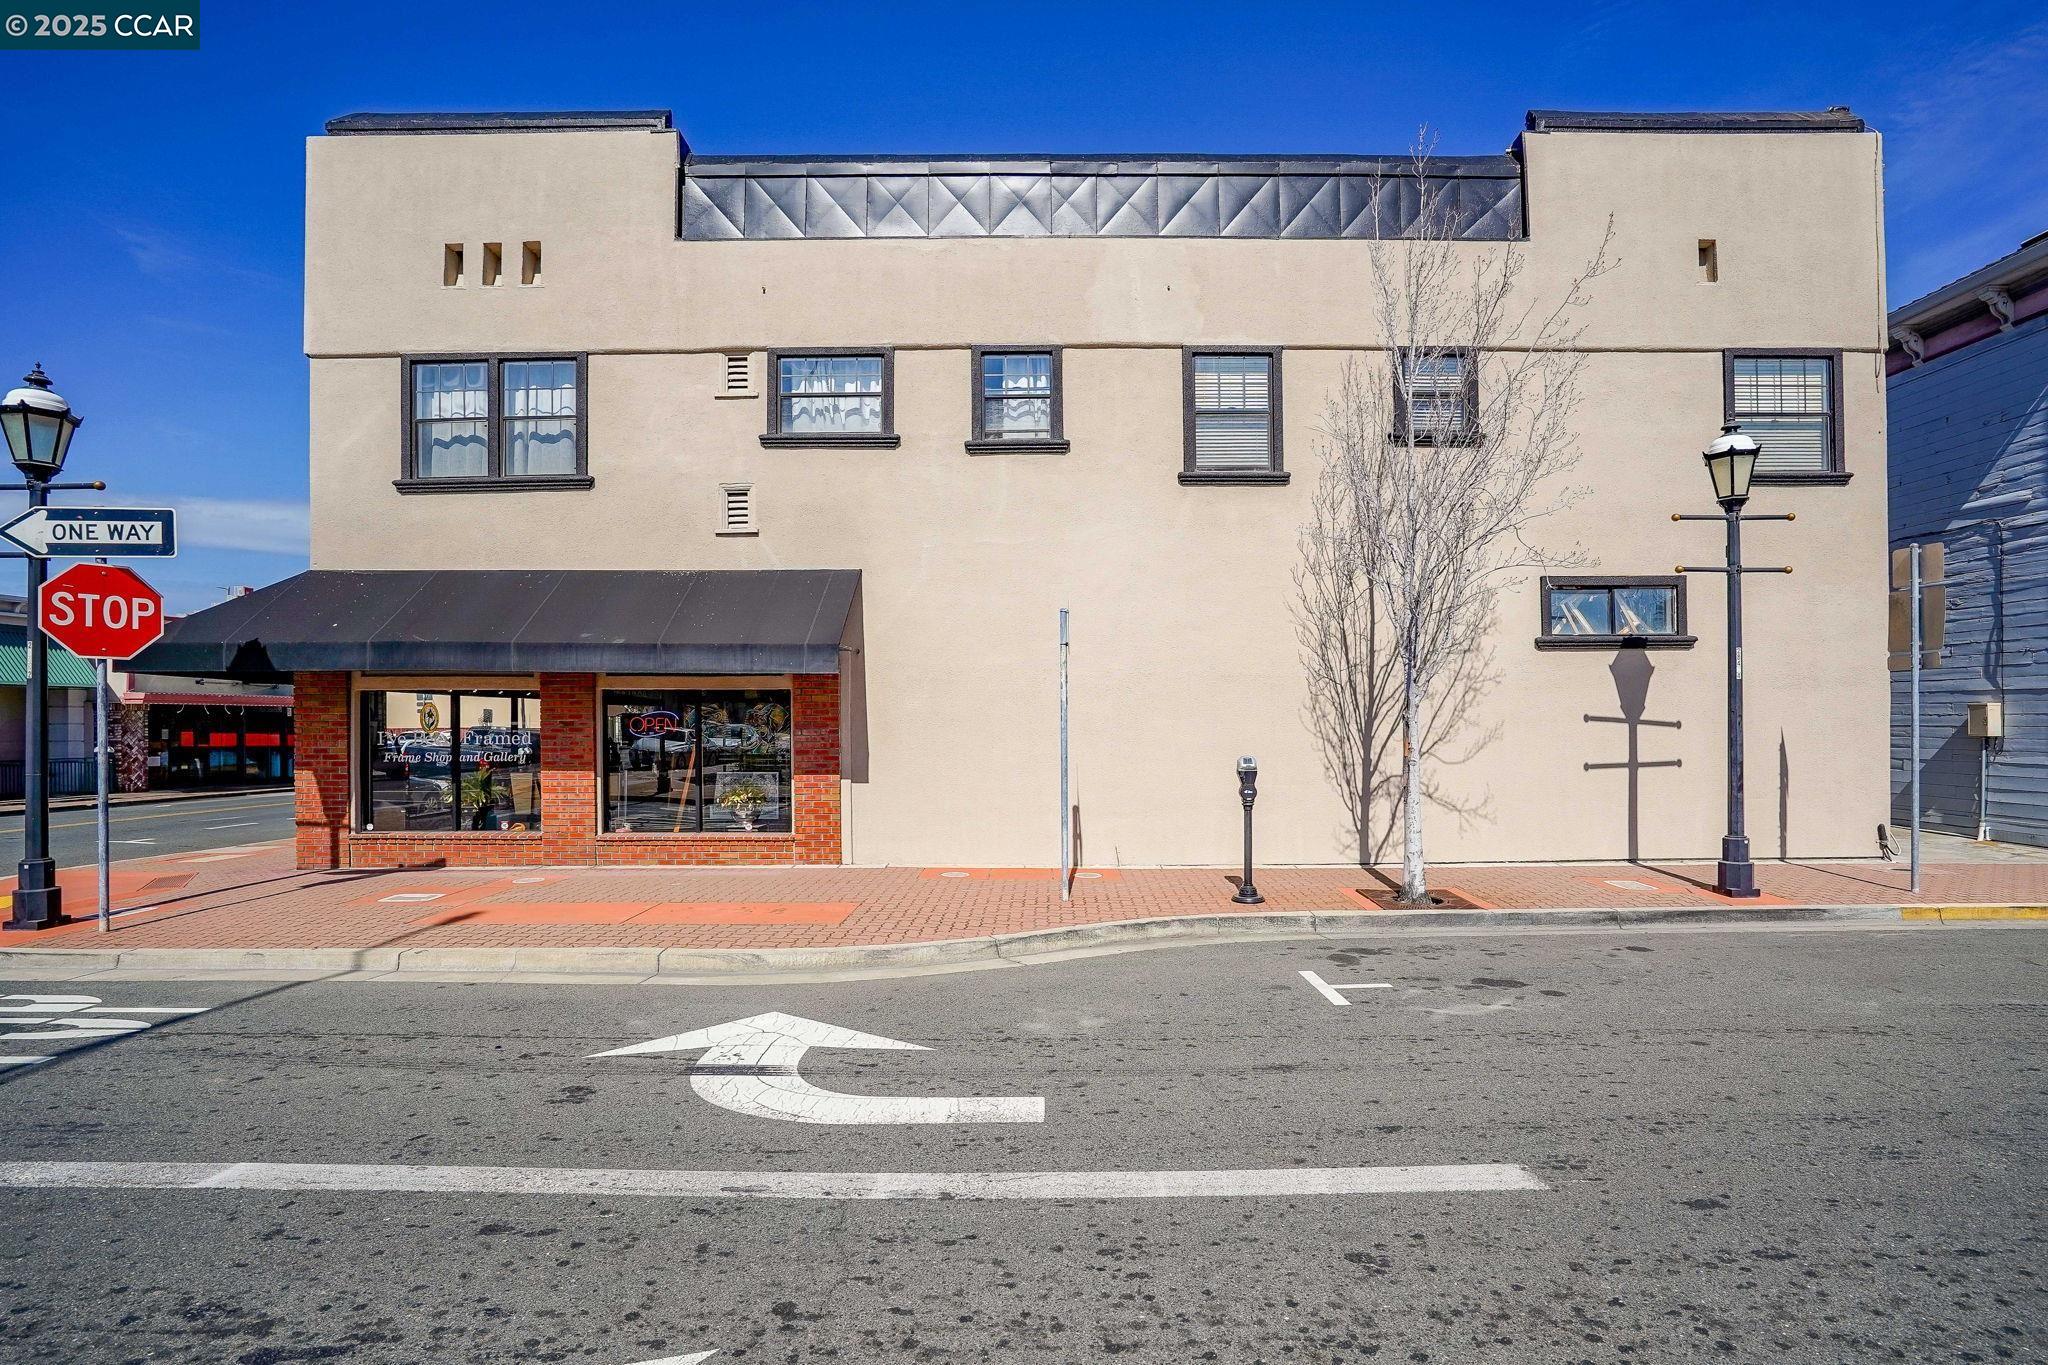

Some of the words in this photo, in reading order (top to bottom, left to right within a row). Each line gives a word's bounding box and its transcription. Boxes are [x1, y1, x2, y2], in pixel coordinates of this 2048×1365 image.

[52, 523, 99, 540] ONE
[107, 524, 155, 541] WAY
[49, 591, 155, 630] STOP
[629, 717, 677, 732] OPEN
[461, 731, 533, 746] Framed
[383, 752, 421, 763] Frame
[424, 752, 452, 764] Shop
[459, 752, 481, 763] and
[483, 752, 527, 765] Gallery
